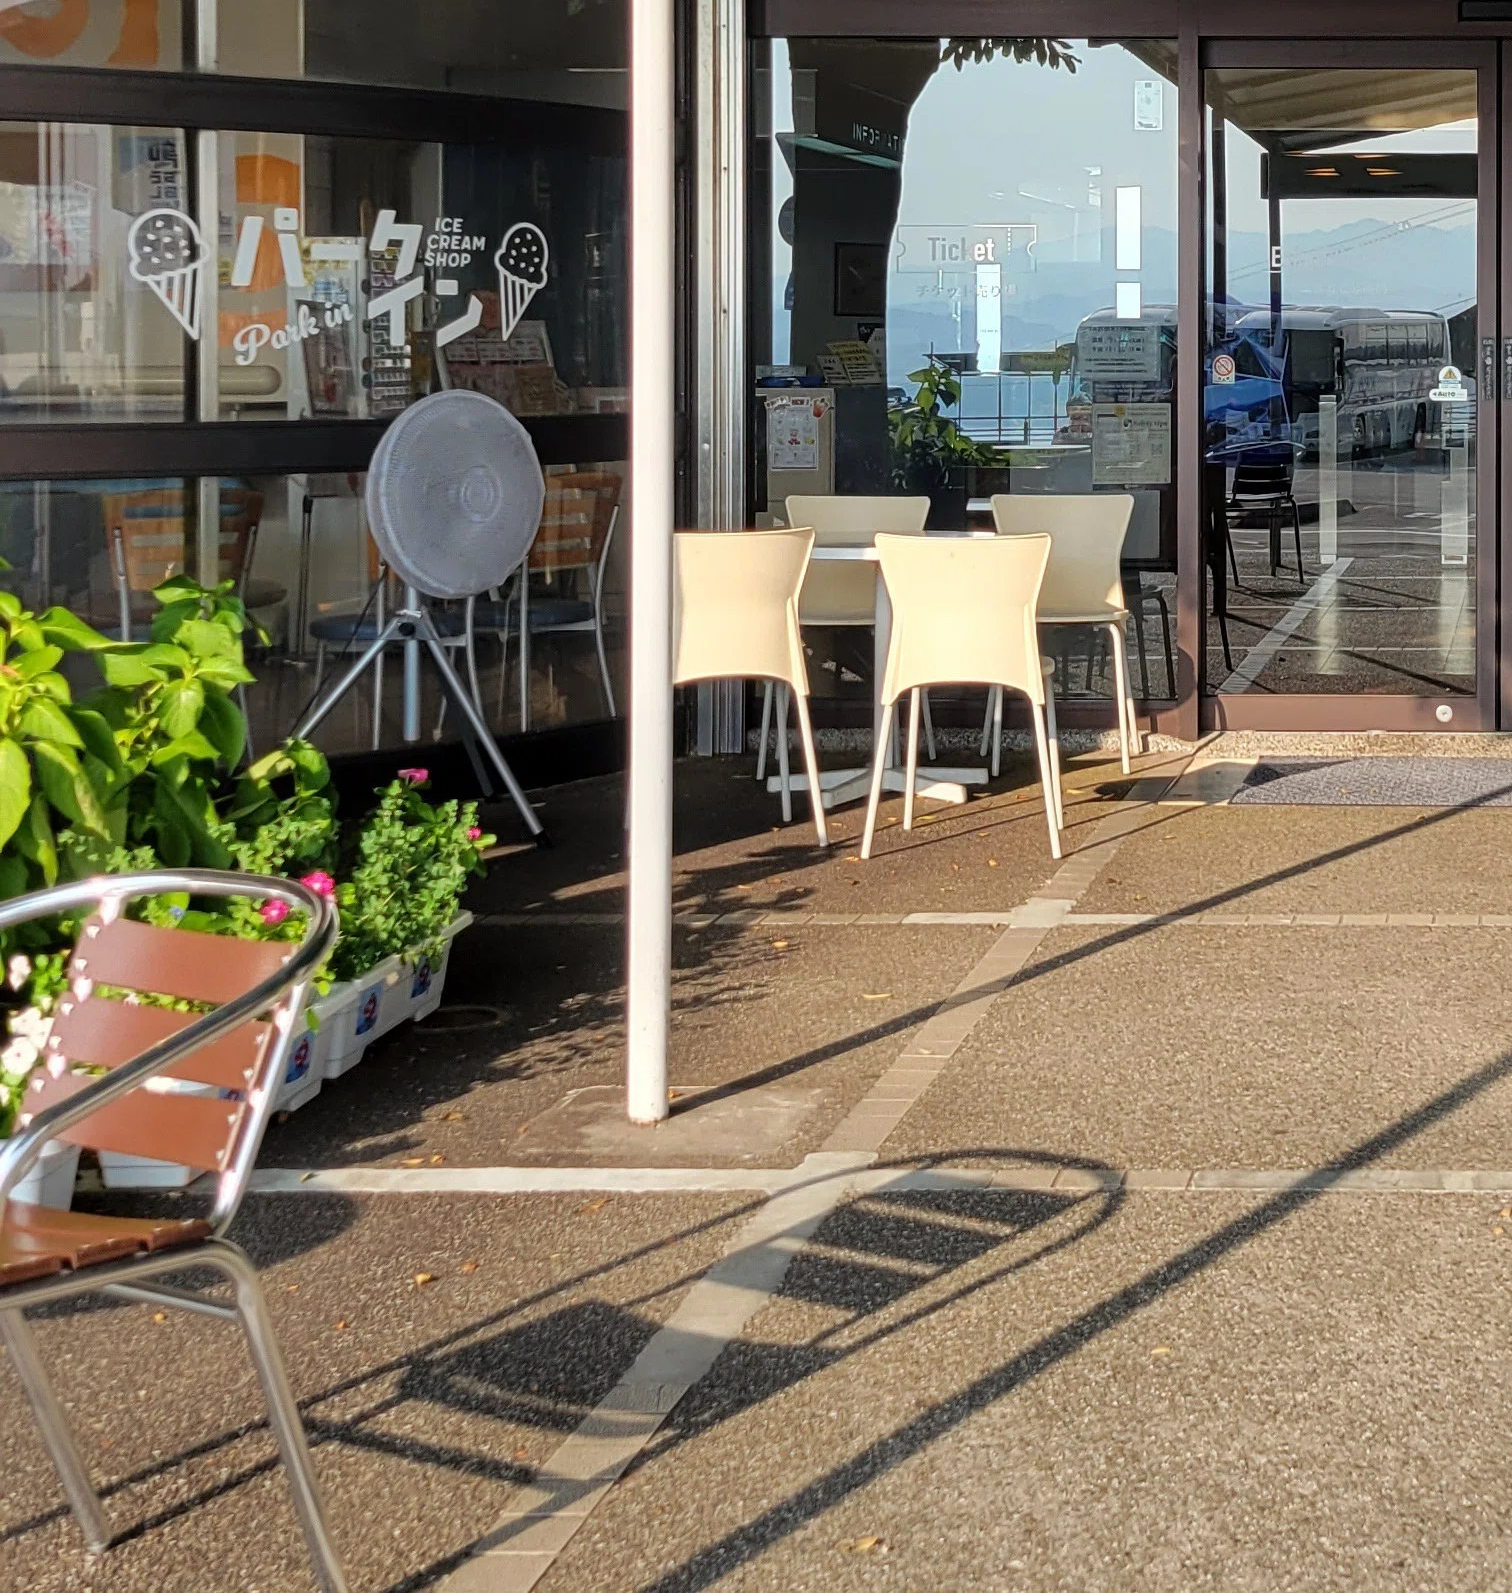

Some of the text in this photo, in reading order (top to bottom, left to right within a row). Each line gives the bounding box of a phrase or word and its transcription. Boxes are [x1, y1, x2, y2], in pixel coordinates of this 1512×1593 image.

[435, 217, 464, 234] ICE
[231, 208, 424, 288] パーク
[427, 234, 486, 252] CREAM
[424, 250, 471, 268] SHOP
[324, 301, 354, 328] in
[367, 275, 484, 349] イン
